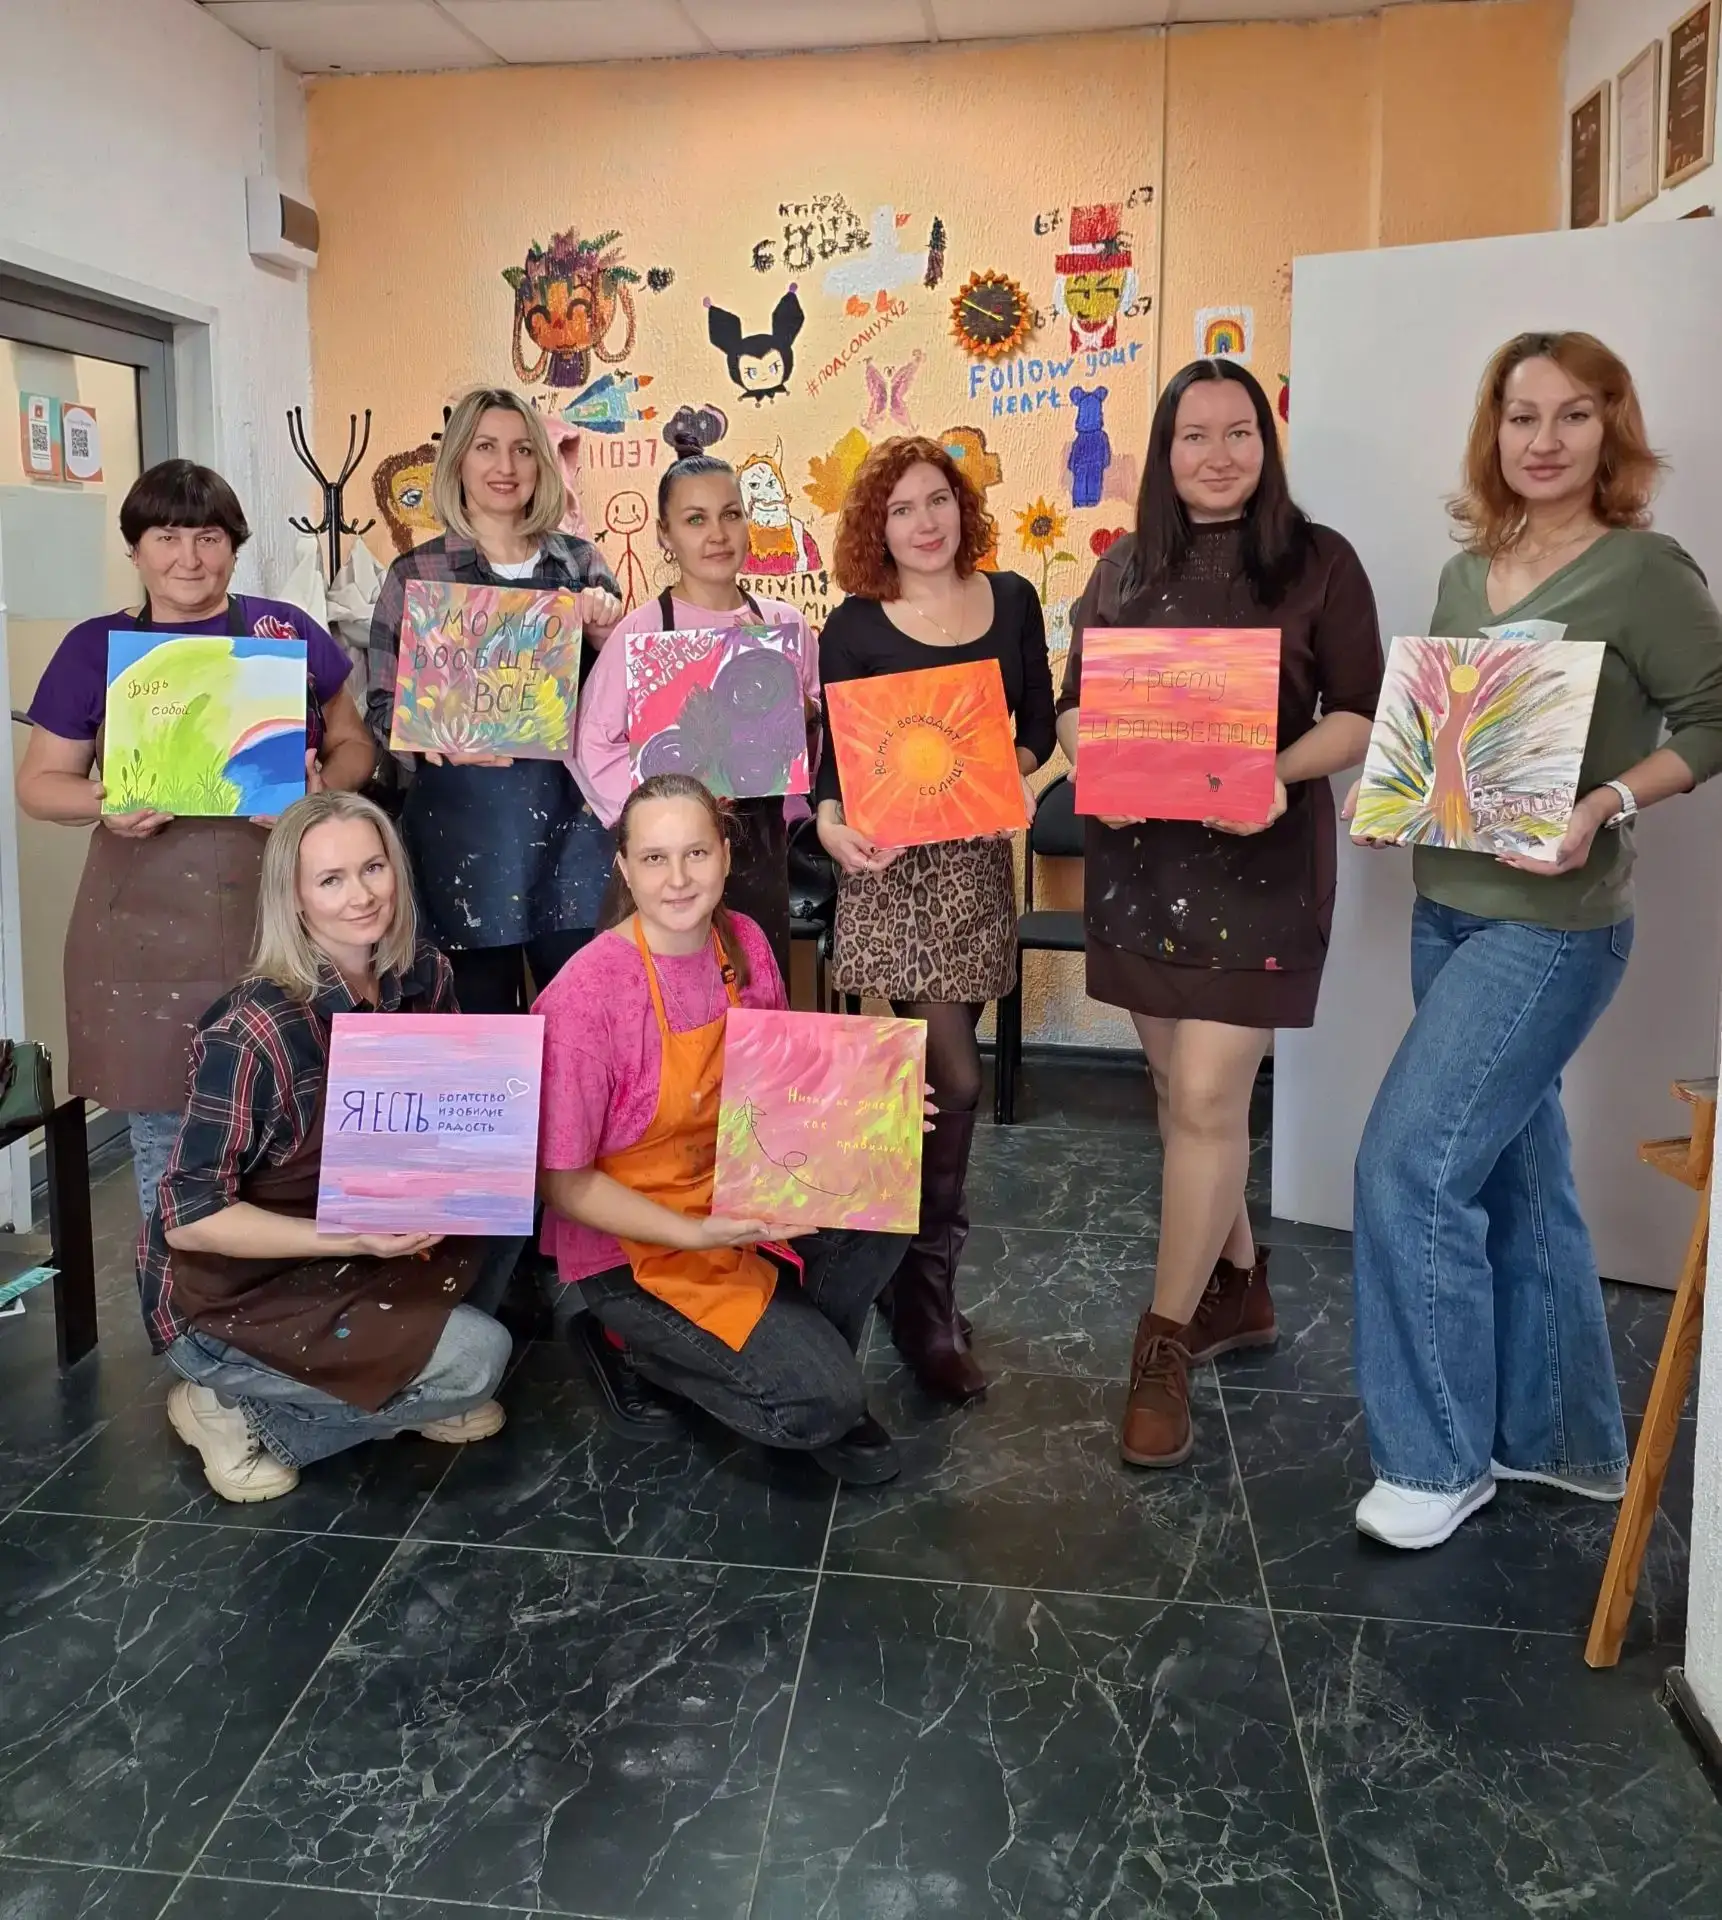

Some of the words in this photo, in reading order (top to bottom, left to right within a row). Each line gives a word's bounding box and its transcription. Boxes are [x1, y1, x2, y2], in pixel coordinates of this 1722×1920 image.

[1127, 186, 1153, 209] 67
[1124, 296, 1152, 318] 67
[969, 358, 1075, 400] Follow
[1085, 341, 1143, 378] your
[440, 609, 562, 640] МОЖНО
[414, 645, 541, 672] ВООБЩЕ
[128, 679, 168, 699] Будь
[151, 701, 191, 716] собой
[896, 713, 962, 742] ВОСХОДИТ
[919, 758, 965, 796] СОЛНЦЕ
[438, 1092, 506, 1103] БОГАТСТВО
[339, 1090, 366, 1132] Я
[372, 1091, 430, 1133] ЕСТЬ
[438, 1107, 504, 1118] ИЗОБИЛИЕ
[437, 1121, 496, 1132] РАДОСТЬ
